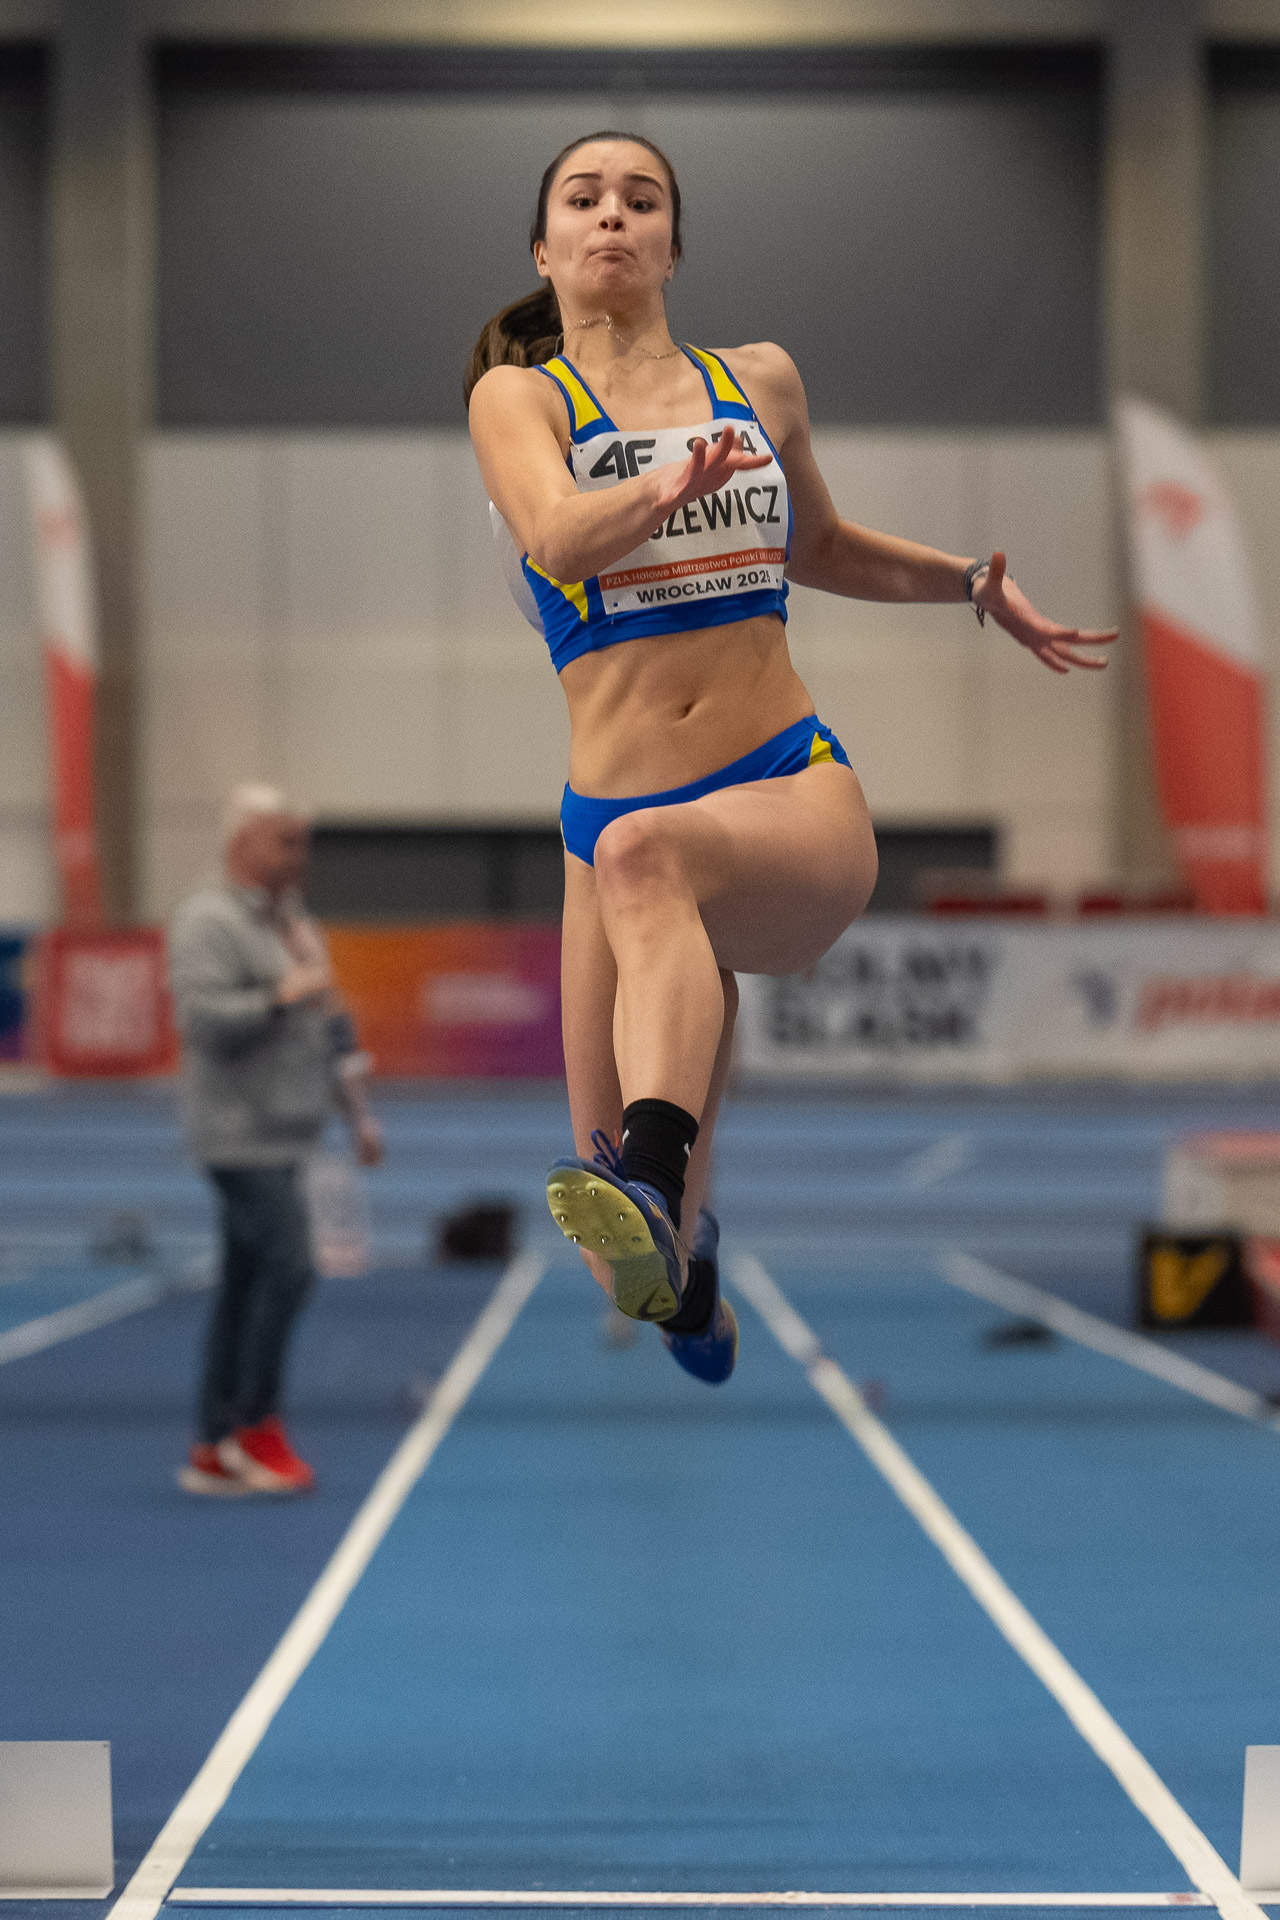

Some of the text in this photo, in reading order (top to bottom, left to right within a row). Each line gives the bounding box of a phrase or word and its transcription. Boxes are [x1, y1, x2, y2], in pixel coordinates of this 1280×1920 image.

[589, 439, 656, 480] 4F
[606, 575, 631, 586] PZLA
[632, 569, 670, 582] Halowe
[671, 559, 728, 575] Mistrzostwa
[729, 551, 759, 566] Polski
[636, 576, 732, 604] WROCŁAW
